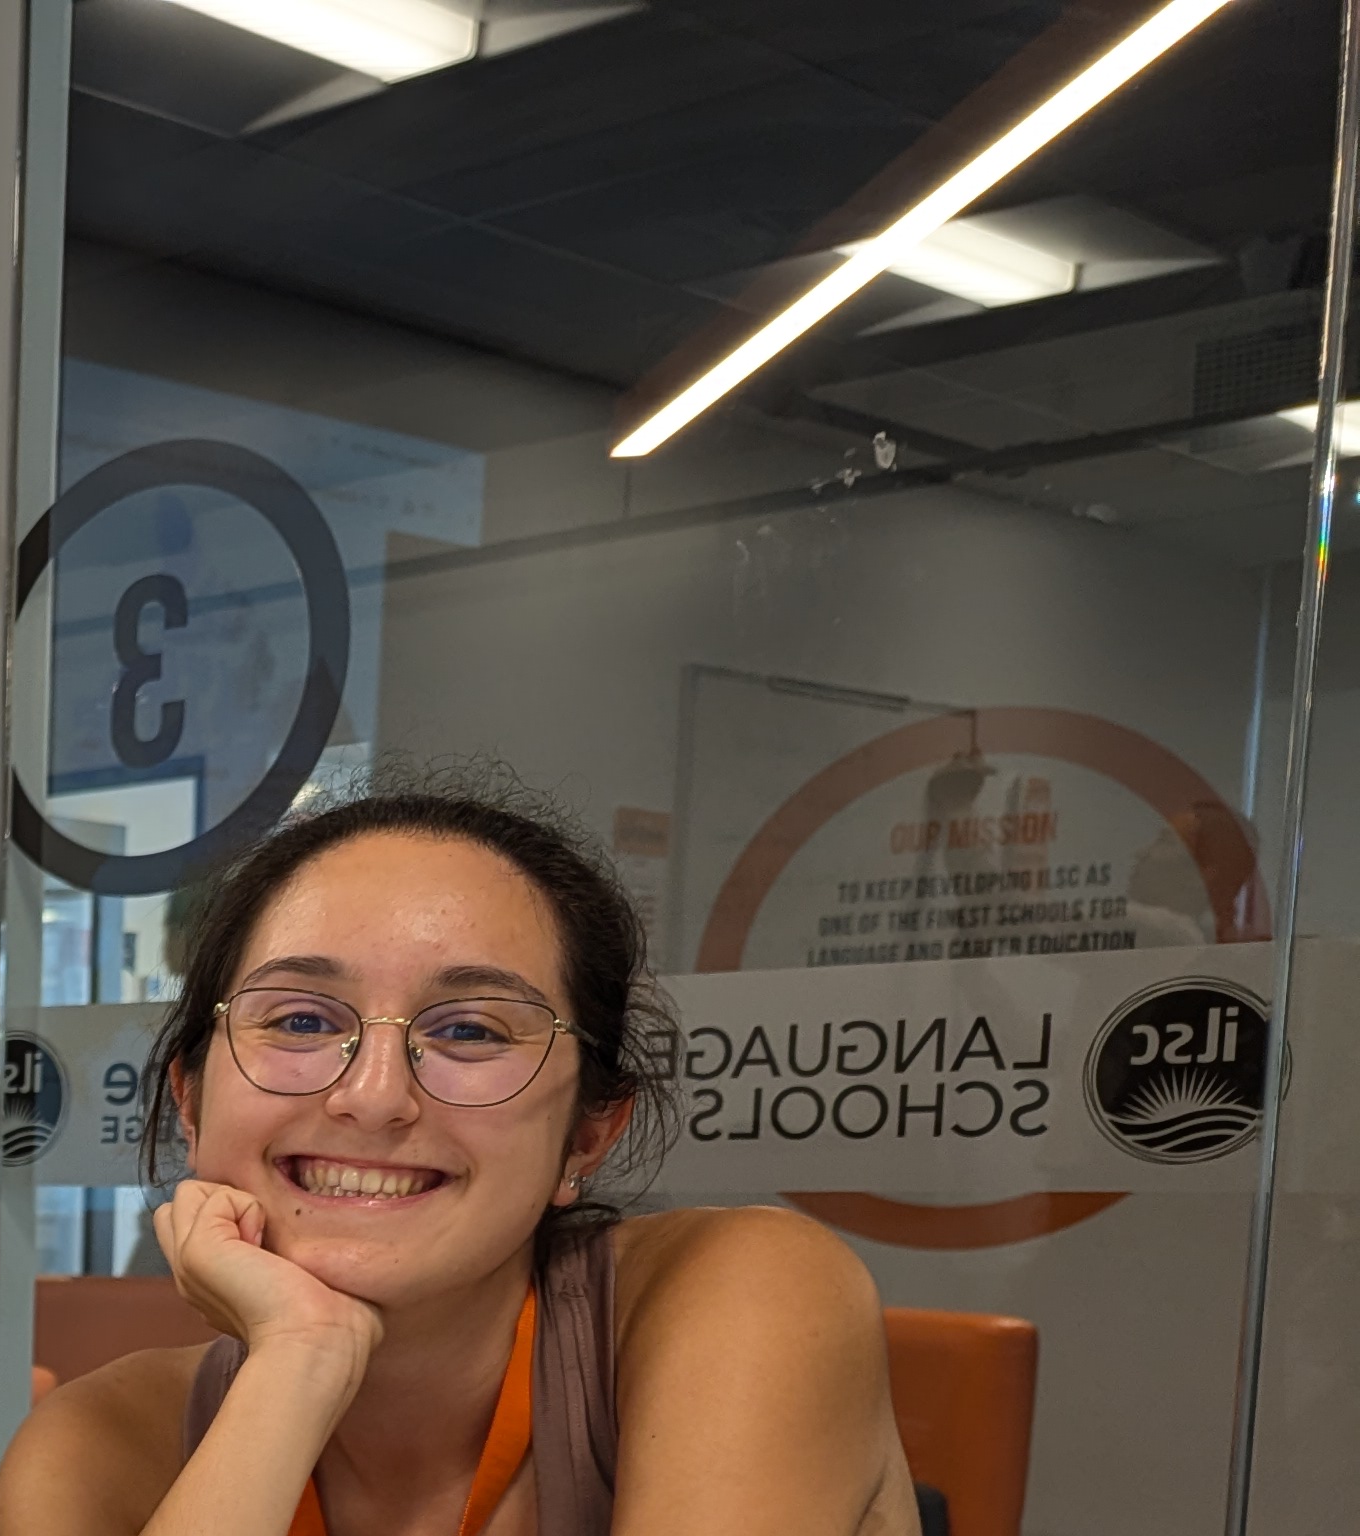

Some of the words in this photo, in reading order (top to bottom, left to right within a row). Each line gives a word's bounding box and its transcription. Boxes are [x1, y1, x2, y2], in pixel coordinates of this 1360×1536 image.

[947, 812, 1058, 850] MISSION
[838, 881, 861, 904] TO
[864, 877, 912, 901] KEEP
[915, 868, 1030, 899] DEVELOPING
[1085, 861, 1112, 886] AS
[856, 913, 879, 935] OF
[888, 909, 920, 932] THE
[925, 905, 993, 931] FINEST
[996, 898, 1085, 928] SCHOOLS
[1089, 896, 1128, 921] FOR
[807, 943, 900, 968] LANGUAGE
[904, 940, 944, 962] AND
[1026, 930, 1137, 956] EDUCATION
